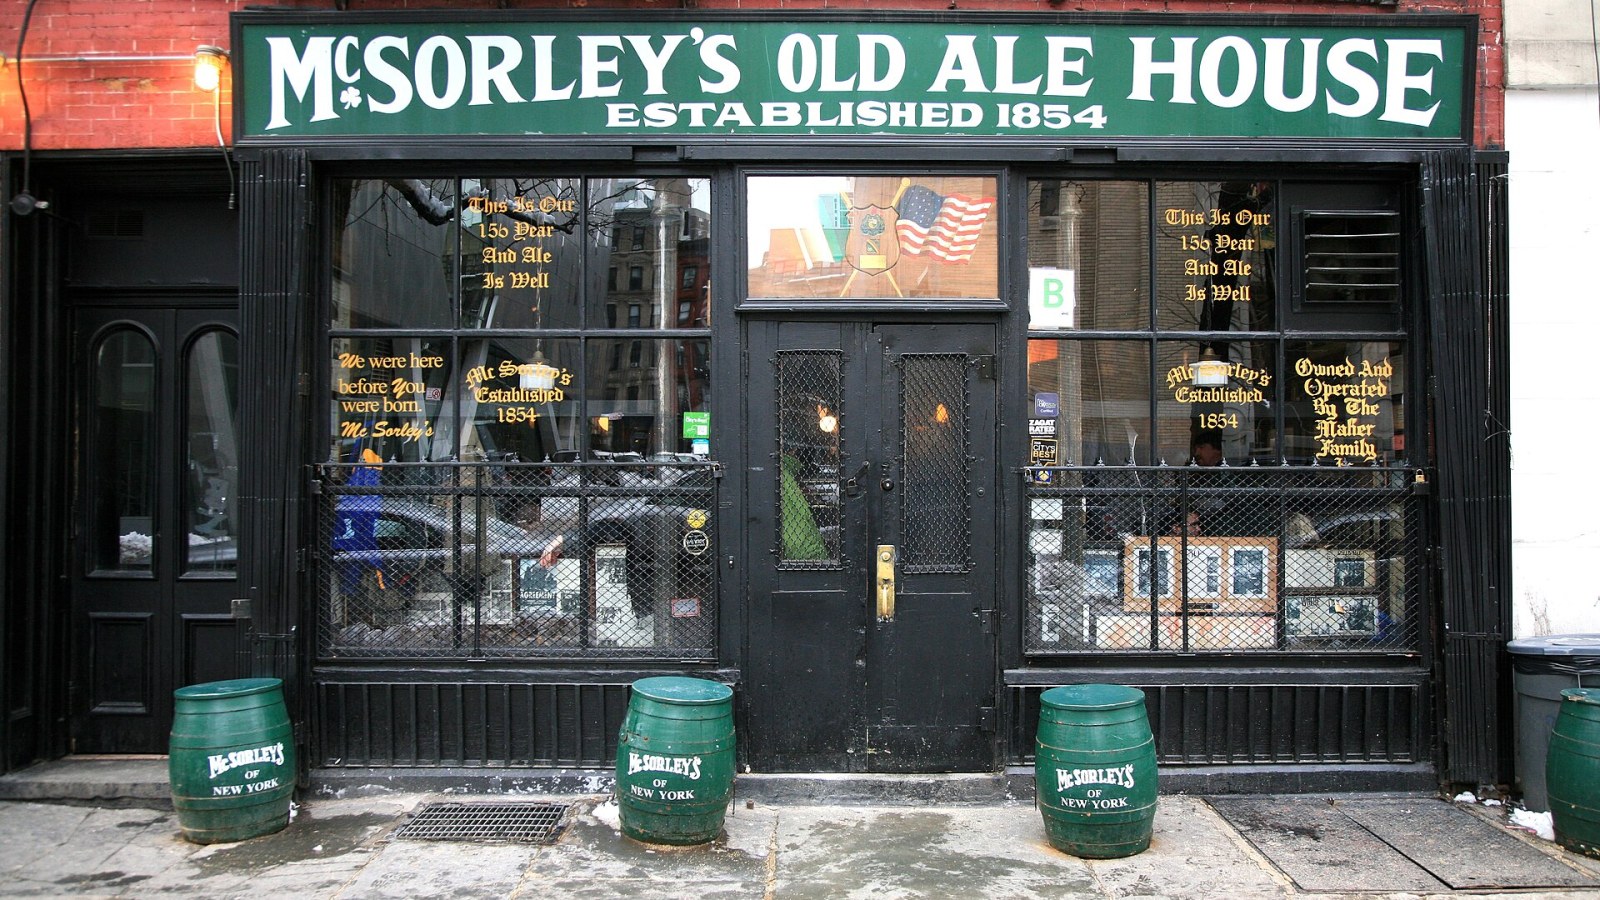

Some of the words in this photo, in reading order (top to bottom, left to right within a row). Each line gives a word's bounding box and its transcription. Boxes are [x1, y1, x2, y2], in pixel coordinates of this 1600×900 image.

[777, 32, 905, 93] OLD
[926, 34, 1094, 97] ALE
[1128, 36, 1443, 127] HOUSE
[605, 101, 984, 129] ESTABLISHED
[996, 103, 1107, 129] 1854
[468, 196, 508, 215] This
[513, 196, 535, 213] Is
[539, 195, 575, 213] Our
[1164, 208, 1205, 228] This
[1209, 208, 1231, 226] Is
[1235, 209, 1271, 226] Our
[479, 223, 509, 239] 156
[513, 221, 555, 241] Year
[1180, 235, 1210, 251] 156
[1214, 233, 1255, 254] Year
[482, 247, 517, 264] And
[521, 246, 553, 264] Ale
[1184, 258, 1219, 276] And
[1223, 259, 1252, 276] Ale
[482, 272, 505, 289] Is
[508, 272, 550, 289] Well
[1043, 278, 1064, 308] B
[1184, 284, 1207, 302] Is
[1211, 284, 1251, 302] Well
[338, 353, 366, 369] We
[368, 356, 407, 369] were
[409, 352, 444, 369] here
[1295, 355, 1355, 377] Owned
[1358, 356, 1393, 378] And
[465, 365, 496, 390] Mc
[498, 360, 574, 386] Sorley's
[1166, 365, 1195, 390] Mc
[1198, 362, 1272, 387] Sorley's
[338, 377, 388, 394] before
[391, 377, 426, 399] You
[474, 386, 564, 405] Established
[1174, 386, 1263, 406] Established
[1304, 377, 1387, 402] Operated
[341, 401, 380, 413] were
[383, 396, 422, 413] born.
[1312, 397, 1338, 420] By
[1343, 396, 1380, 416] The
[497, 406, 541, 423] 1854
[1199, 413, 1239, 429] 1854
[341, 421, 368, 438] Mc
[371, 420, 435, 442] Sorley's
[1028, 426, 1055, 434] RATED
[1315, 438, 1377, 462] Family
[244, 769, 260, 780] OF
[653, 778, 667, 788] OF
[212, 784, 244, 796] NEW
[245, 777, 279, 794] YORK
[630, 784, 655, 798] NEW
[659, 789, 695, 800] YORK
[1087, 789, 1102, 798] OF
[1061, 796, 1087, 808] NEW
[1091, 797, 1129, 809] YORK
